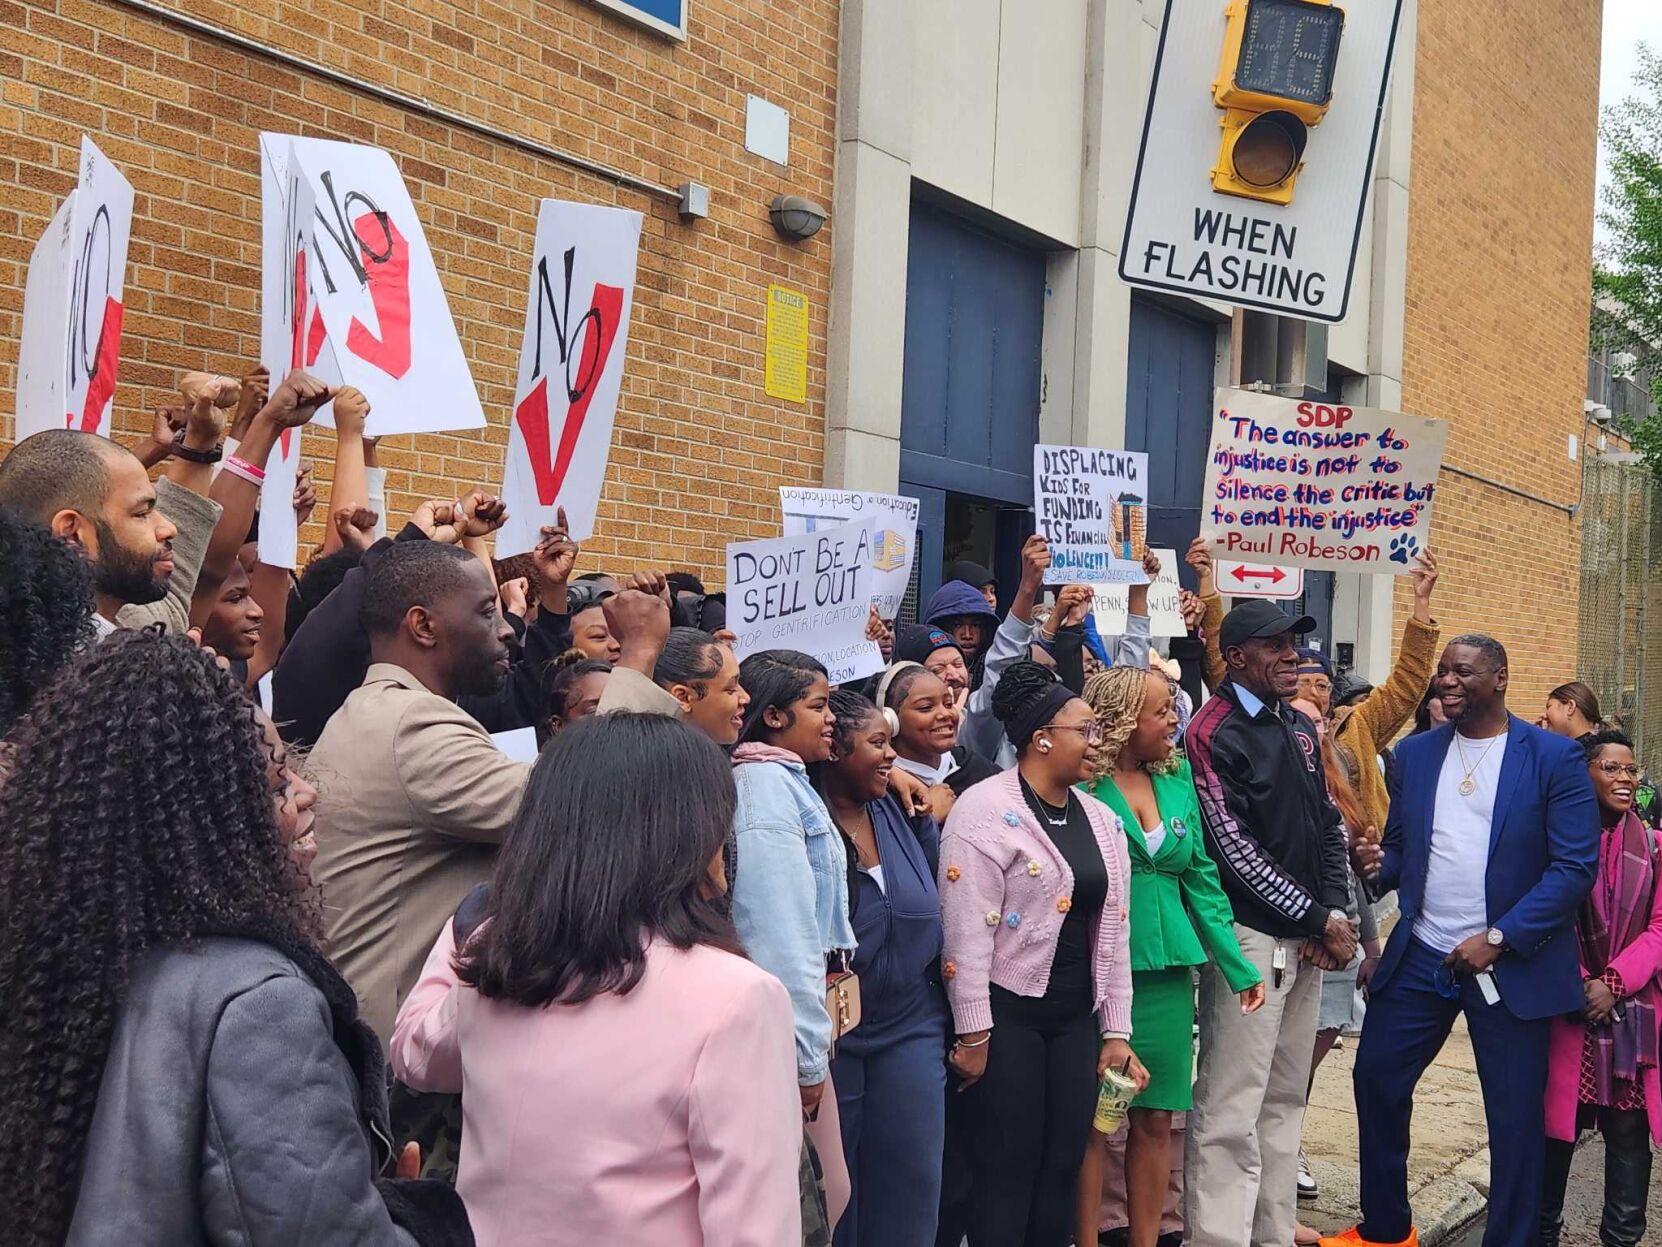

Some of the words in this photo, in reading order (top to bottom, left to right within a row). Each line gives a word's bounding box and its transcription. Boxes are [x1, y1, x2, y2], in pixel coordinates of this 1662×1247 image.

[313, 170, 393, 294] NO
[1194, 207, 1297, 259] WHEN
[1144, 240, 1326, 306] FLASHING
[531, 246, 602, 404] NO
[1296, 402, 1353, 428] SDP
[1283, 430, 1370, 449] answer
[1376, 428, 1409, 450] to
[1043, 449, 1137, 481] DISPLACING
[1214, 444, 1287, 477] injustice
[1289, 453, 1312, 476] is
[1316, 454, 1362, 477] not
[1369, 456, 1402, 474] to
[782, 490, 863, 511] Gentrification
[1293, 482, 1335, 504] the
[1341, 480, 1399, 503] critic
[1403, 482, 1436, 502] but
[876, 496, 918, 521] Education
[1043, 497, 1102, 521] FUNDING
[1211, 504, 1236, 525] to
[1240, 505, 1284, 527] end
[1284, 506, 1327, 529] the
[1040, 519, 1062, 544] IS
[733, 547, 806, 585] DON'T
[816, 537, 845, 574] BE
[853, 529, 869, 564] A
[1280, 533, 1380, 561] Robeson
[743, 580, 807, 623] SELL
[815, 565, 861, 607] OUT
[1095, 596, 1125, 614] PENN,
[731, 630, 762, 650] STOP
[772, 605, 866, 640] GENTRIFICATION
[836, 642, 877, 663] LOCATION
[830, 666, 856, 682] ESON
[1295, 732, 1315, 772] P
